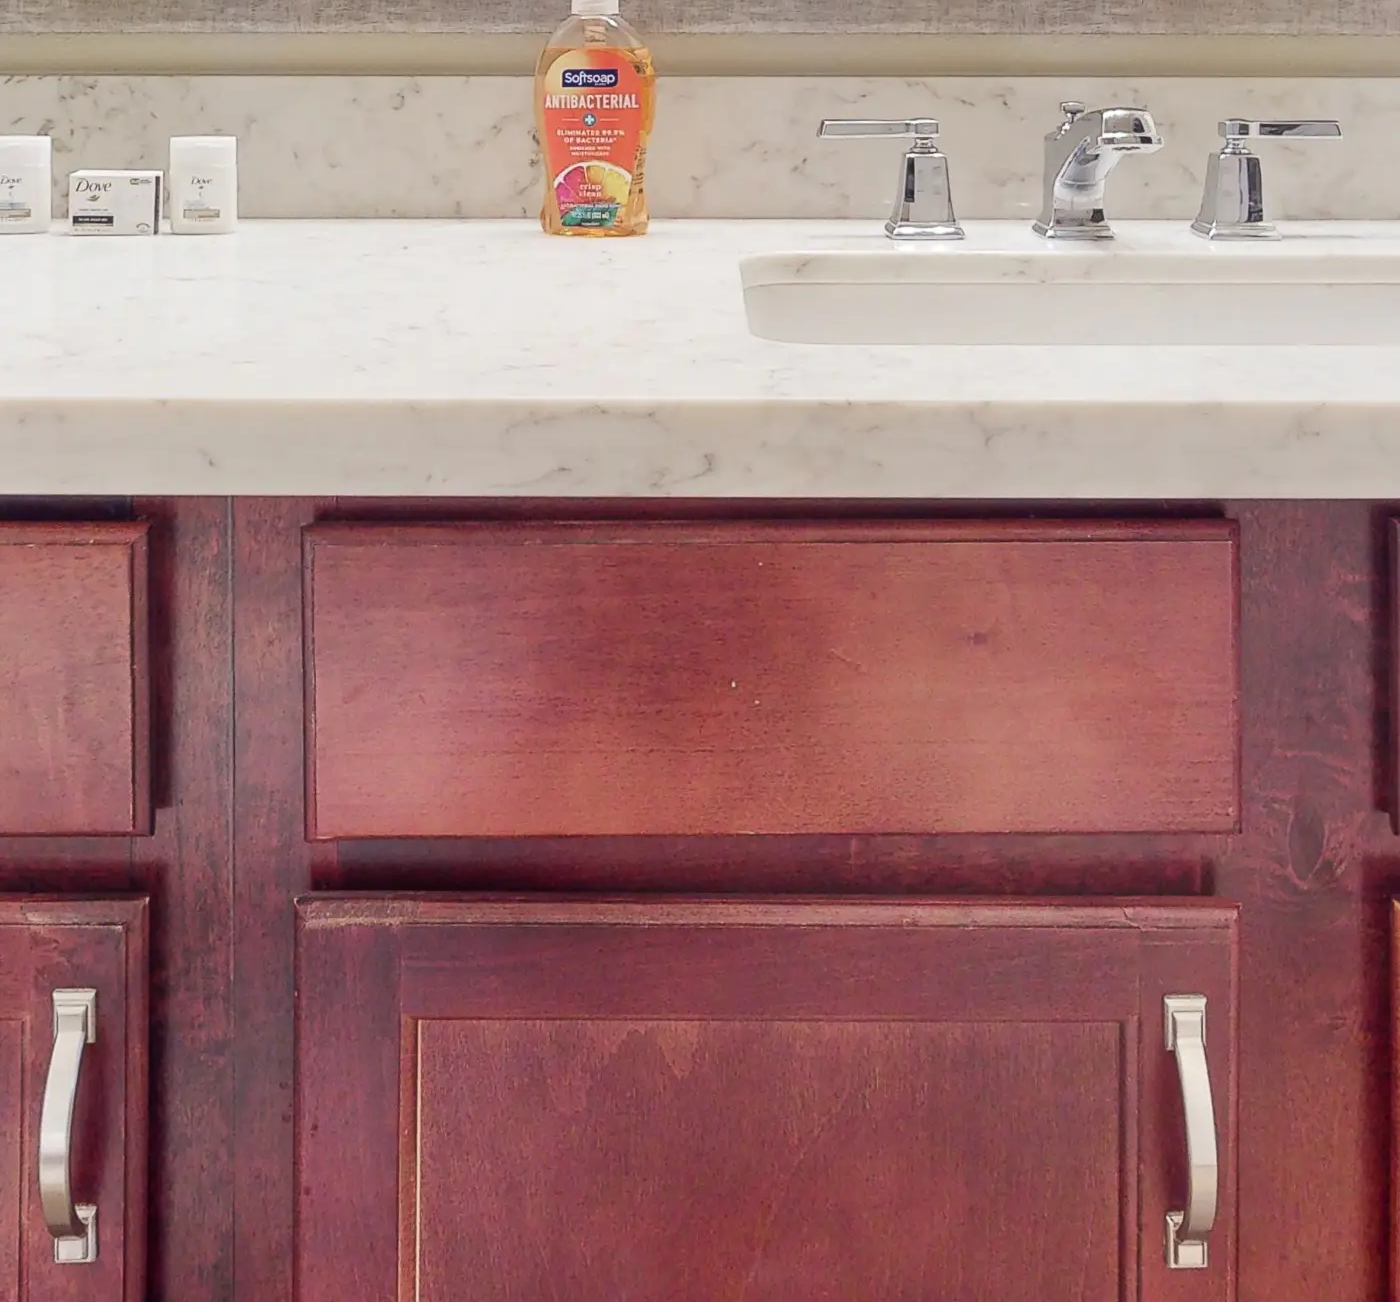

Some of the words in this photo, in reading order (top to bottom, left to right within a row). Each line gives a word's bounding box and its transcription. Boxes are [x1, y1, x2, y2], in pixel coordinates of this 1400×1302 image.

[564, 71, 616, 85] Softsoap
[545, 94, 639, 109] ANTIBACTERIAL
[75, 177, 112, 192] Dove
[191, 175, 213, 185] Dove
